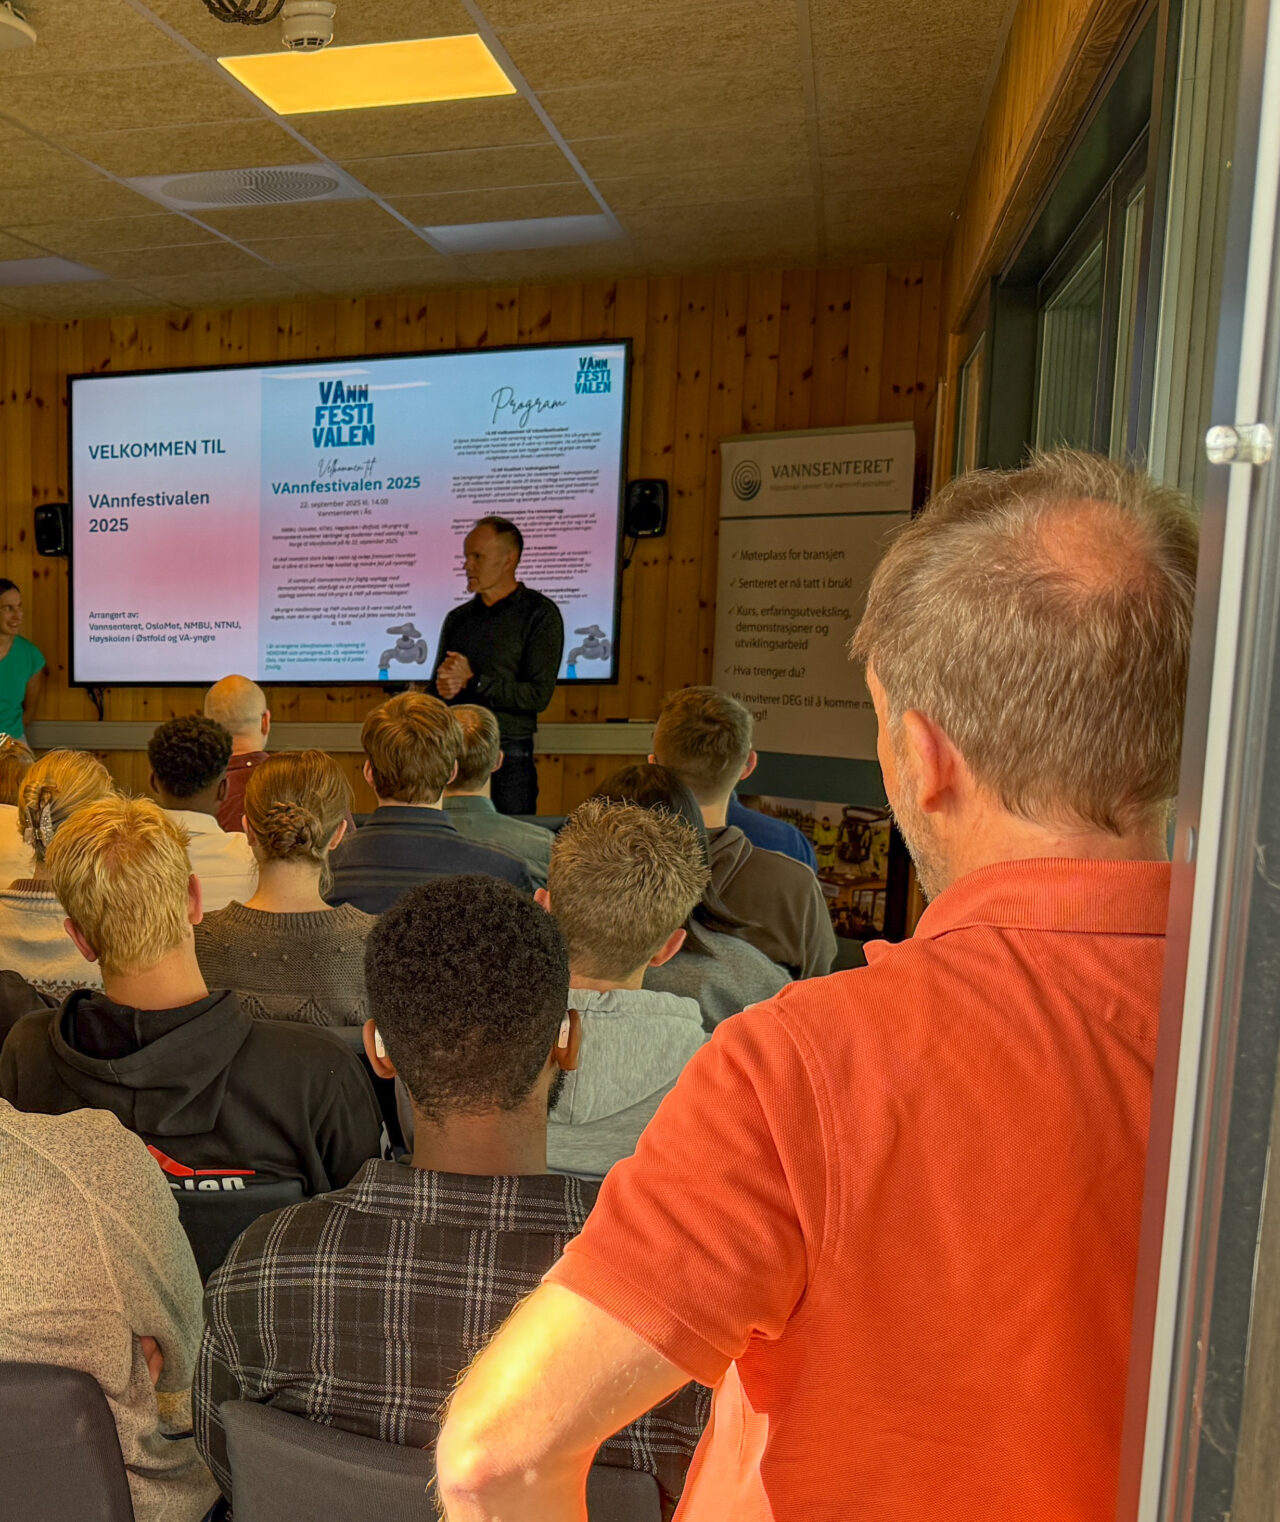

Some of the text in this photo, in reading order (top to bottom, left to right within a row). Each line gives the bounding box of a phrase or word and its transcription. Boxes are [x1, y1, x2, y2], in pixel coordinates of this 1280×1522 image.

[576, 369, 611, 382] FESTI
[575, 381, 612, 394] VALEN
[490, 386, 567, 428] Program
[315, 403, 374, 427] FESTI
[313, 424, 375, 448] VALEN
[88, 439, 227, 460] VELKOMMEN TIL
[771, 458, 894, 479] VANNSENTERET
[271, 476, 421, 495] VAnnfestivalen 2025
[88, 490, 210, 509] VAnnfestivalen
[88, 517, 129, 533] 2025
[739, 549, 845, 562] Møteplass for bransjen
[738, 578, 777, 589] Senteret
[778, 580, 788, 589] er
[789, 578, 801, 589] nå
[802, 579, 820, 589] tatt
[827, 578, 853, 589] bruk!
[89, 611, 139, 621] Arrangert av:
[736, 605, 852, 620] Kurs, erfaringsutveksling,
[89, 621, 242, 631] Vannsenteret, OsloMet, NMBU, NTNU,
[735, 621, 829, 637] demonstrasjoner og
[89, 634, 130, 644] Høyskolen
[136, 633, 166, 643] Østfold
[167, 635, 178, 644] og
[179, 633, 216, 644] VA-yngre
[735, 637, 808, 651] utviklingsarbeid
[733, 665, 806, 679] Hva trenger du?
[743, 692, 780, 705] inviterer
[782, 694, 802, 706] DEG
[804, 694, 814, 707] til
[815, 695, 822, 707] å
[823, 696, 860, 709] komme
